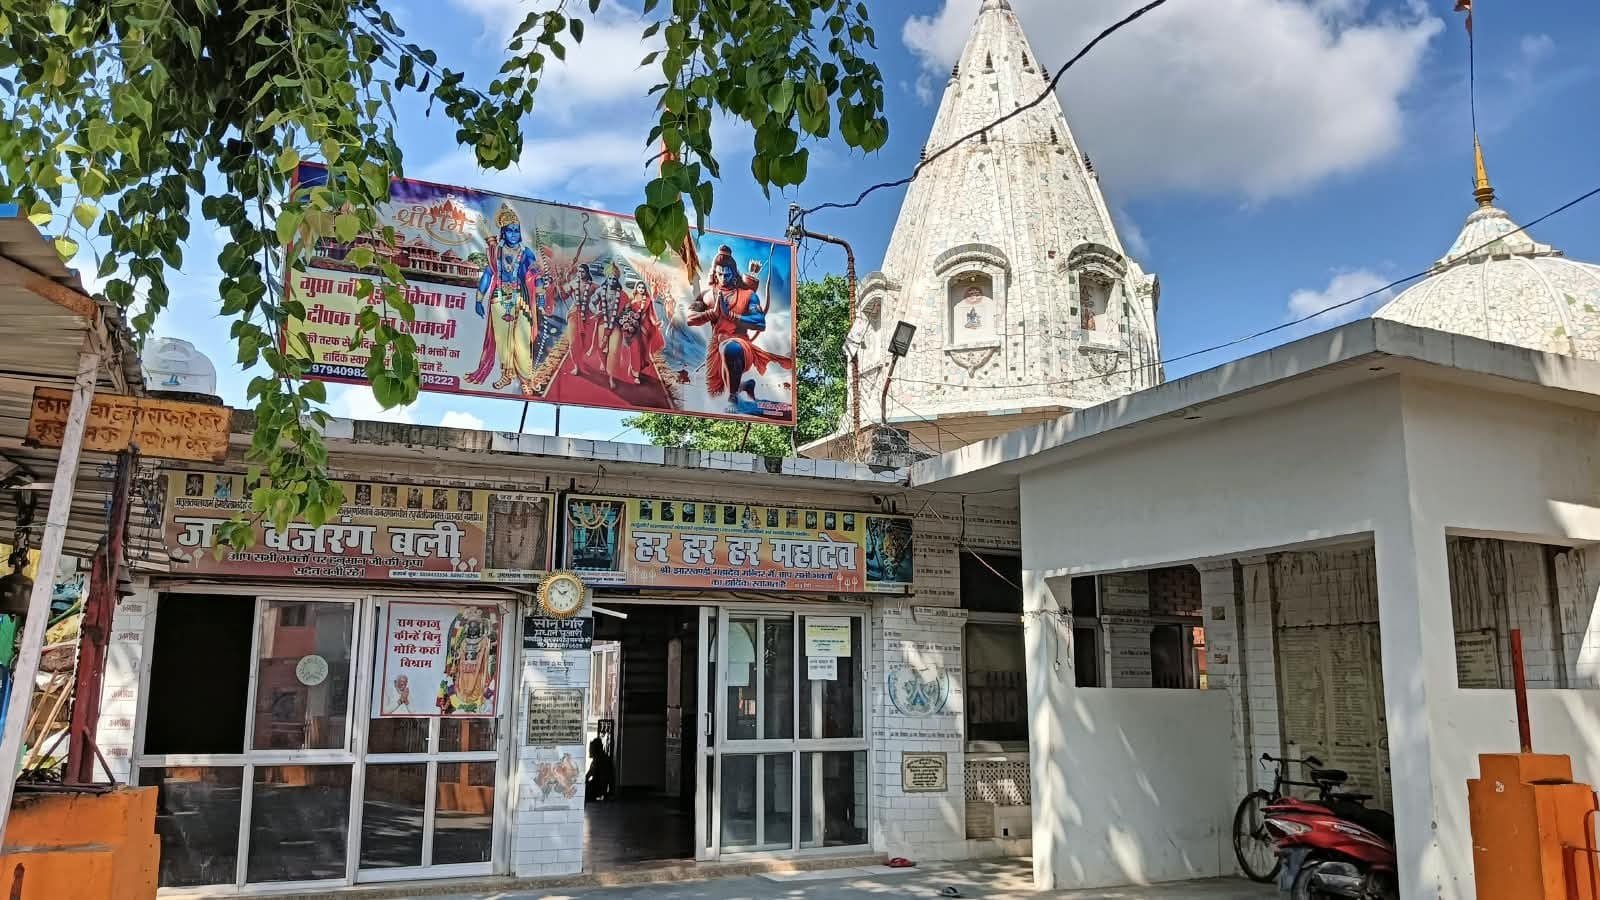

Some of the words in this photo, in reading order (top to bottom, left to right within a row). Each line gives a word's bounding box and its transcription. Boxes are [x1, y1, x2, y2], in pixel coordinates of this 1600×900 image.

[444, 292, 466, 310] एवं
[307, 303, 350, 326] दीपक
[319, 336, 341, 346] तरफ
[428, 348, 447, 358] भक्तों
[449, 350, 461, 359] का
[312, 363, 369, 380] 97940982
[261, 515, 377, 556] बजरंग
[387, 520, 465, 559] बली
[632, 531, 672, 563] हर
[680, 533, 718, 566] हर
[725, 535, 762, 567] हर
[769, 531, 858, 571] महादेव
[228, 552, 250, 561] आप
[254, 552, 277, 563] सभी
[312, 555, 327, 566] पर
[329, 557, 366, 569] हनुमान
[369, 556, 383, 567] जी
[384, 556, 400, 567] की
[401, 558, 424, 571] कृपा
[398, 618, 415, 628] राम
[416, 618, 441, 631] काजु
[393, 630, 421, 641] कीन्हें
[423, 630, 442, 645] बिनु
[393, 643, 417, 654] मोहि
